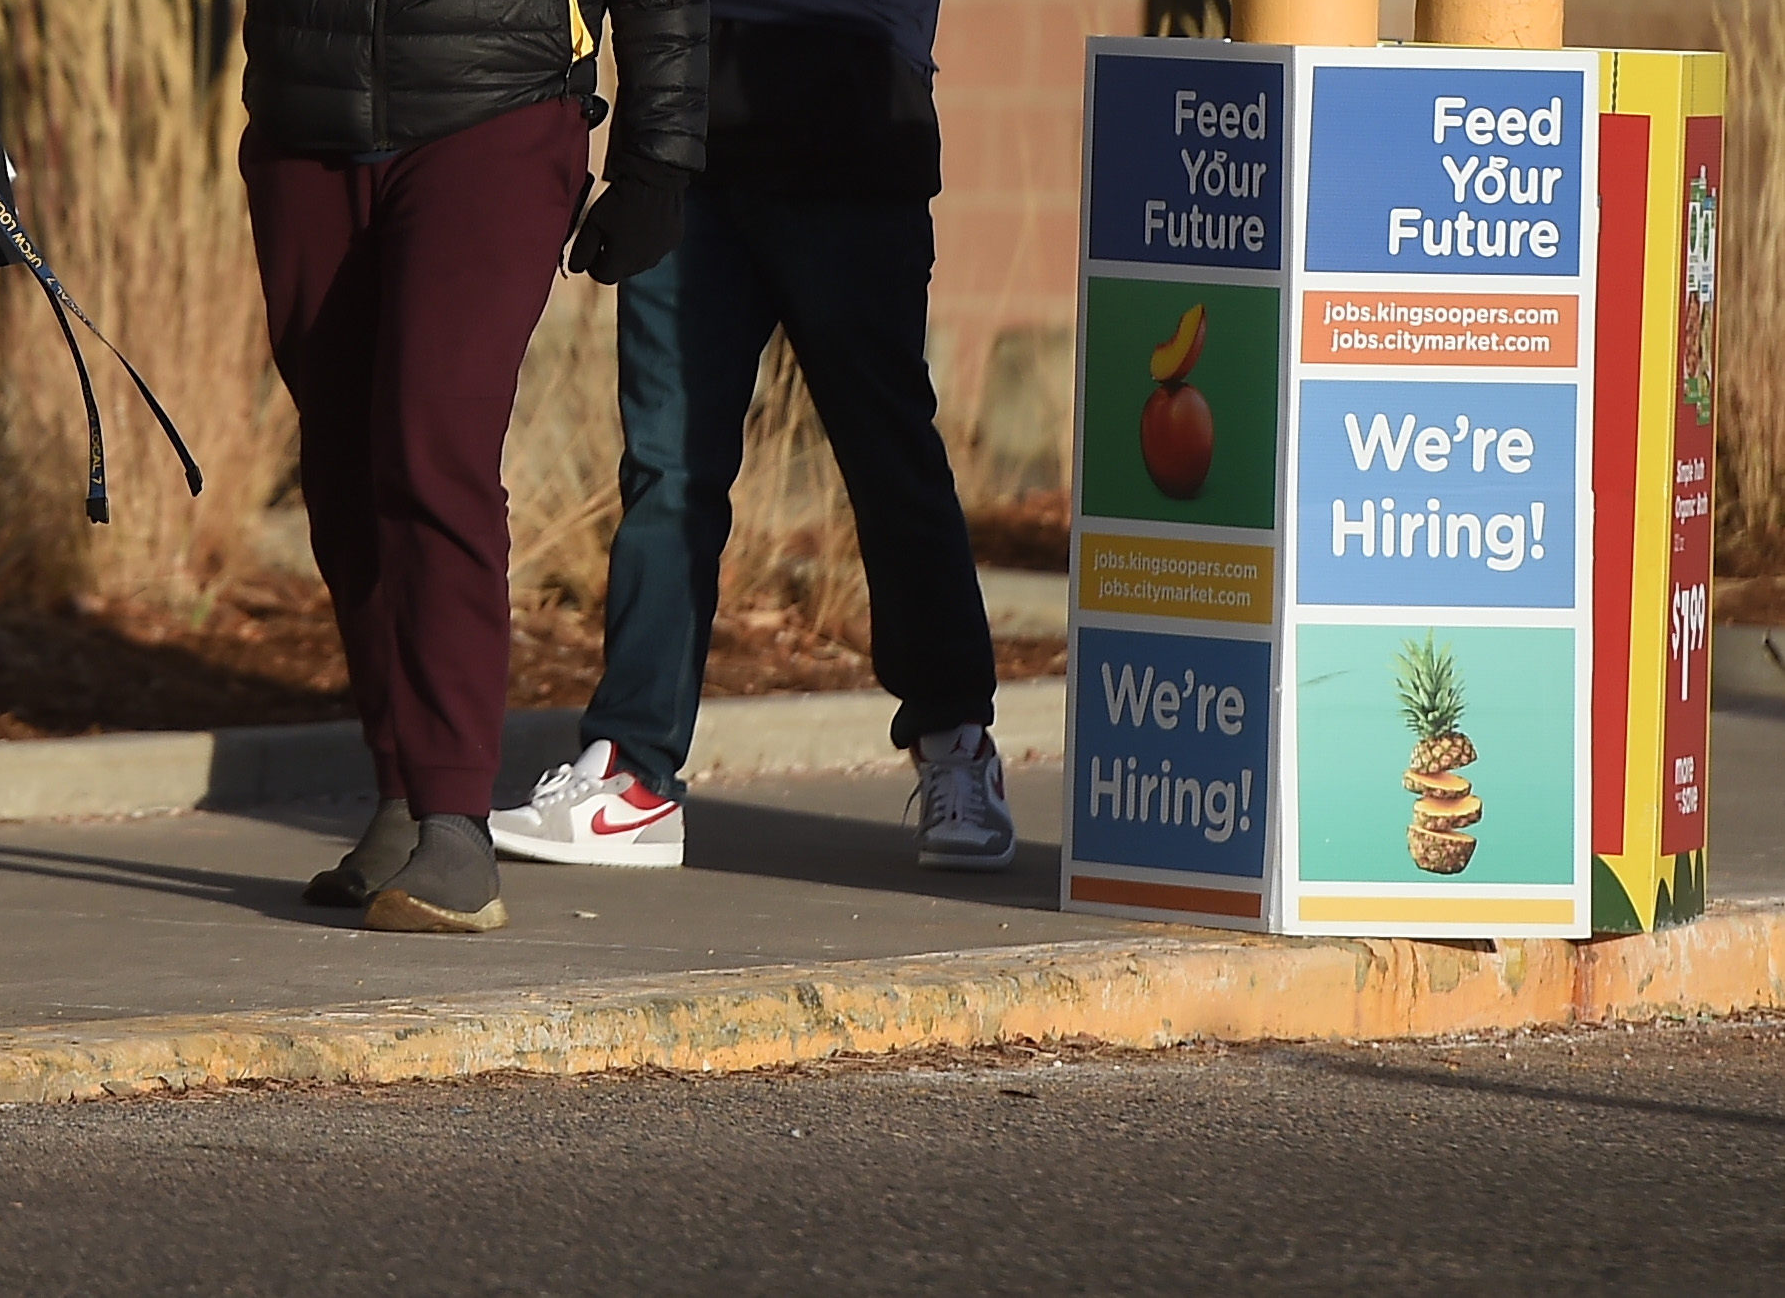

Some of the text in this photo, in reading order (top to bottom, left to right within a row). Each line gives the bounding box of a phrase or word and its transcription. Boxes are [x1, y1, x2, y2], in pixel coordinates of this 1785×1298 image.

[1174, 90, 1266, 140] Feed
[1432, 96, 1562, 146] Feed
[1181, 149, 1267, 198] Your
[1441, 155, 1563, 204] Your
[12, 231, 44, 269] UFCW
[1144, 200, 1265, 252] Future
[1387, 208, 1559, 258] Future
[1323, 301, 1560, 327] jobs.kingsoopers.com
[1331, 328, 1550, 353] jobs.citymarket.com
[1343, 413, 1535, 473] We're
[1331, 498, 1546, 571] Hiring!
[1094, 548, 1258, 580] jobs.kingsoopers.com
[1099, 577, 1251, 607] jobs.citymarket.com
[1101, 661, 1245, 736] We're
[1089, 755, 1253, 843] Hiring!
